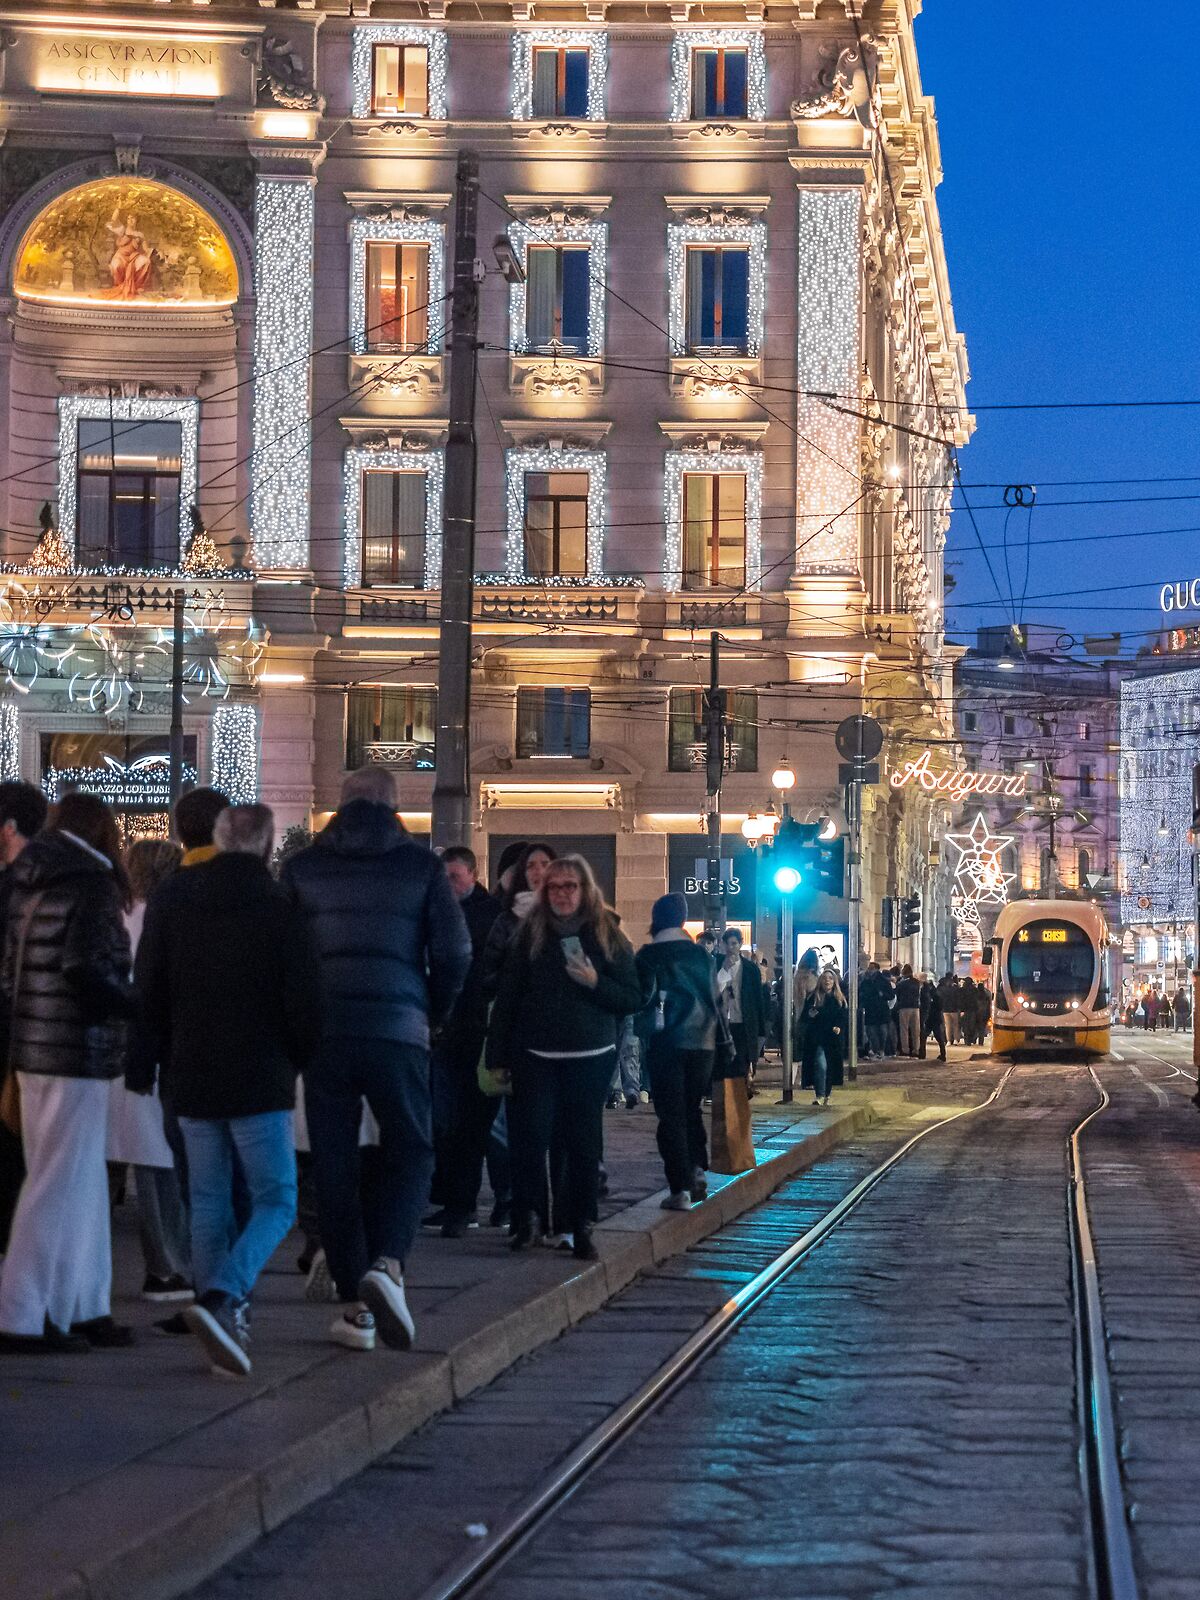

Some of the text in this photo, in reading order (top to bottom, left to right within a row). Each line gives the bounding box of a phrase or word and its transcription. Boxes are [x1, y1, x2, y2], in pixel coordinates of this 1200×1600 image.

[48, 42, 213, 65] ASSICVRAZIONI
[890, 750, 1029, 802] Auguri
[79, 784, 171, 794] PALAZZO CORDUSI
[148, 796, 171, 804] HOTE
